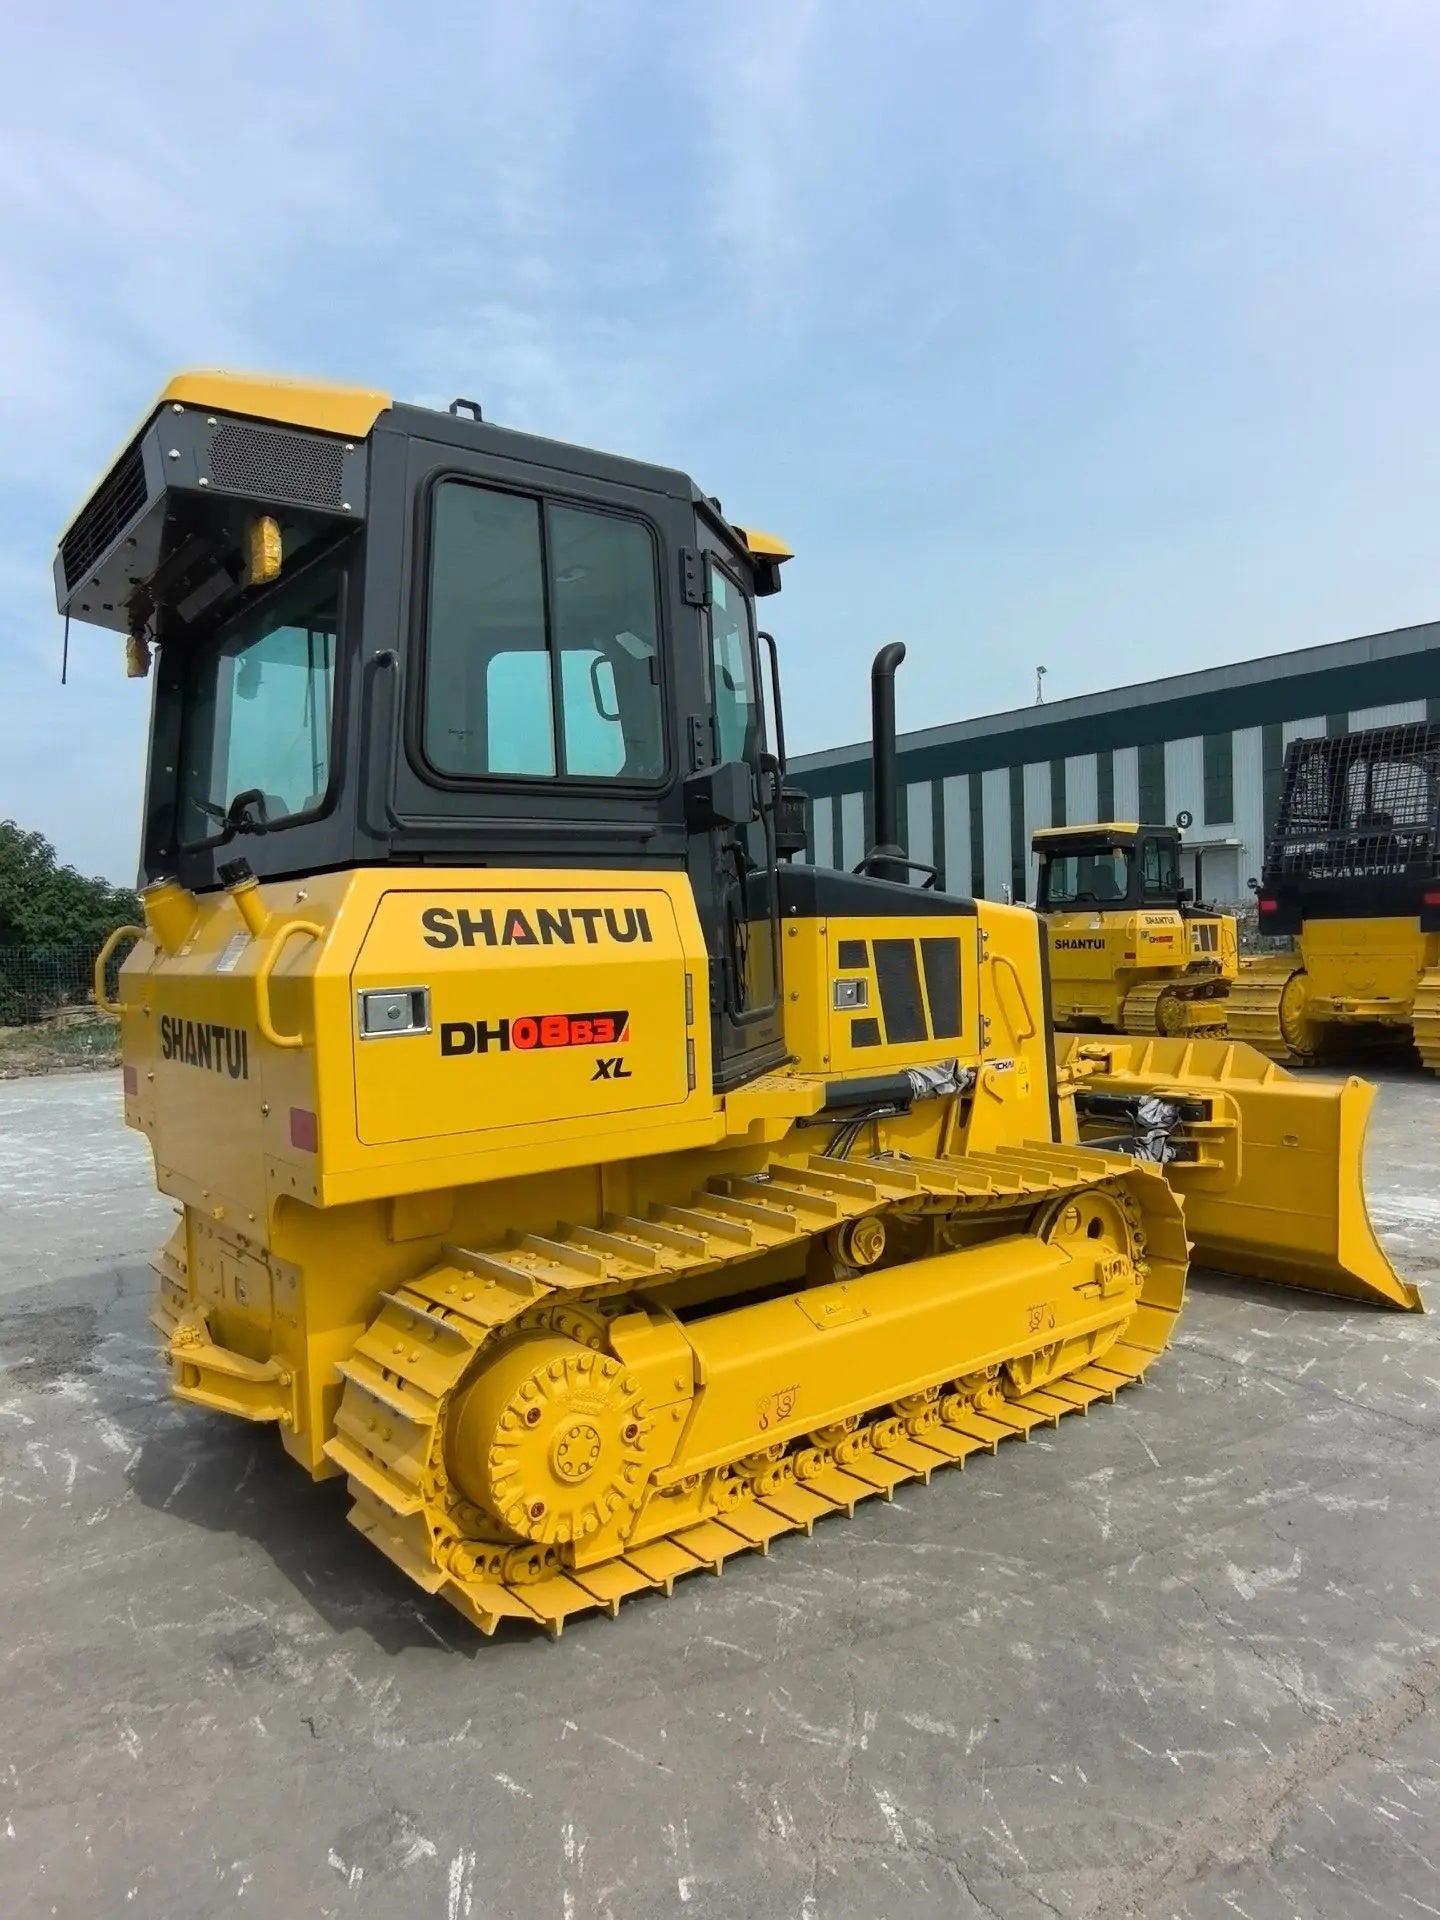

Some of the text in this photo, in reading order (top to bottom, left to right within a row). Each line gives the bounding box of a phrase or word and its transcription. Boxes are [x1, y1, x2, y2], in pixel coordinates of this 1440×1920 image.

[1181, 814, 1188, 826] 9
[421, 908, 653, 949] SHANTUI
[1055, 939, 1105, 949] SHANTUI
[161, 1014, 249, 1080] SHANTUI
[590, 1057, 632, 1081] XL
